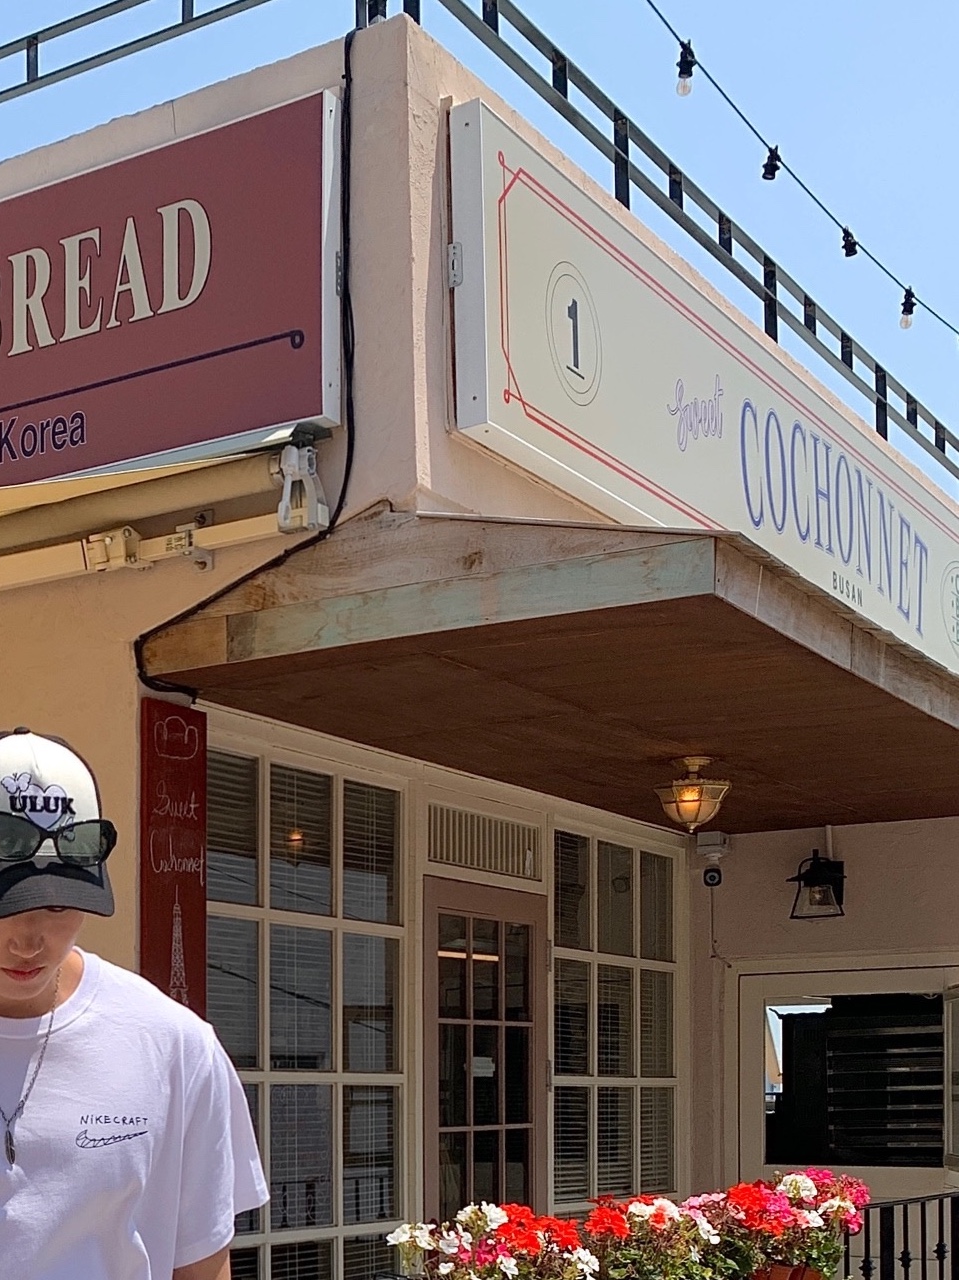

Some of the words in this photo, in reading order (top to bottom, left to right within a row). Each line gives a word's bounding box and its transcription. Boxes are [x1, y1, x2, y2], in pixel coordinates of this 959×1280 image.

[566, 298, 585, 380] 1
[666, 374, 724, 452] Sweet
[740, 398, 928, 638] COCHONNET
[832, 571, 864, 608] BUSAN
[9, 795, 76, 815] ULUK
